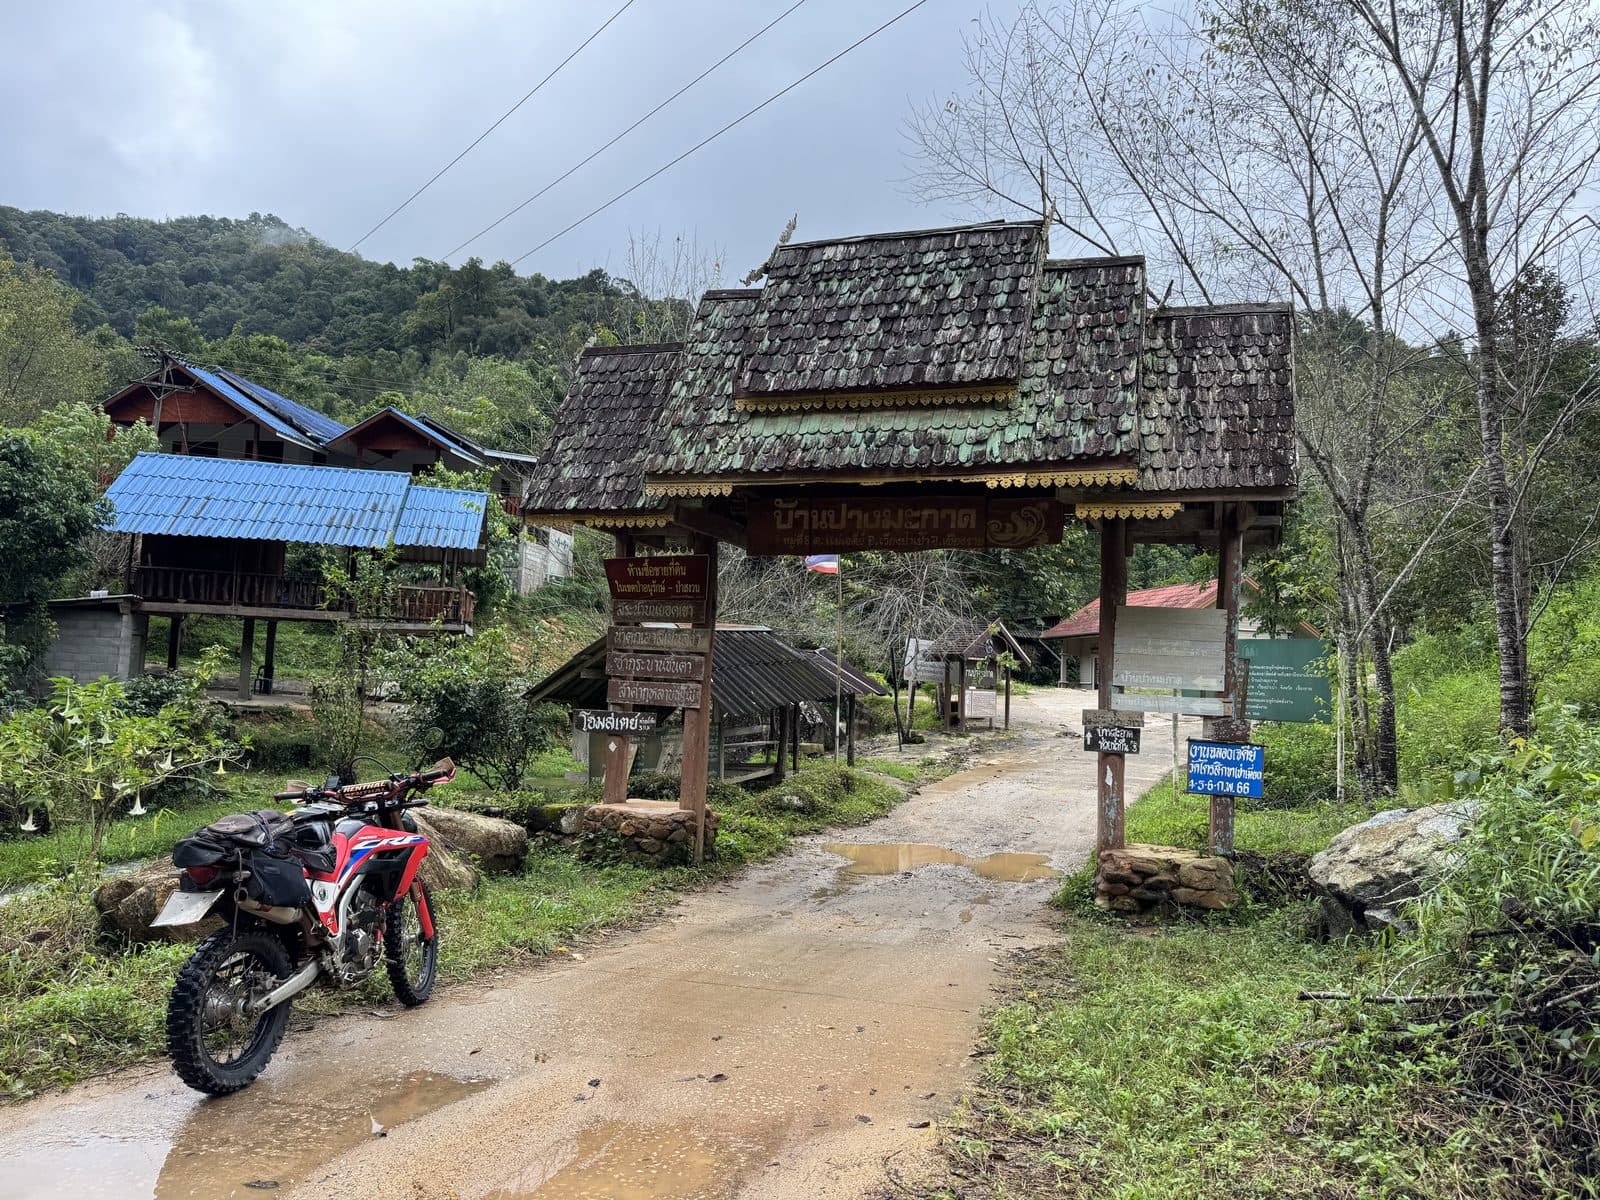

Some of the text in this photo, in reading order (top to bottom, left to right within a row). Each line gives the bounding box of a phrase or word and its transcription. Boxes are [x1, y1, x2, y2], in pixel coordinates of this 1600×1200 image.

[773, 498, 977, 529] บ้านปางมะกาด
[627, 558, 686, 576] ห้ามซื้อขายที่ดิน
[343, 781, 386, 793] RENTHAL
